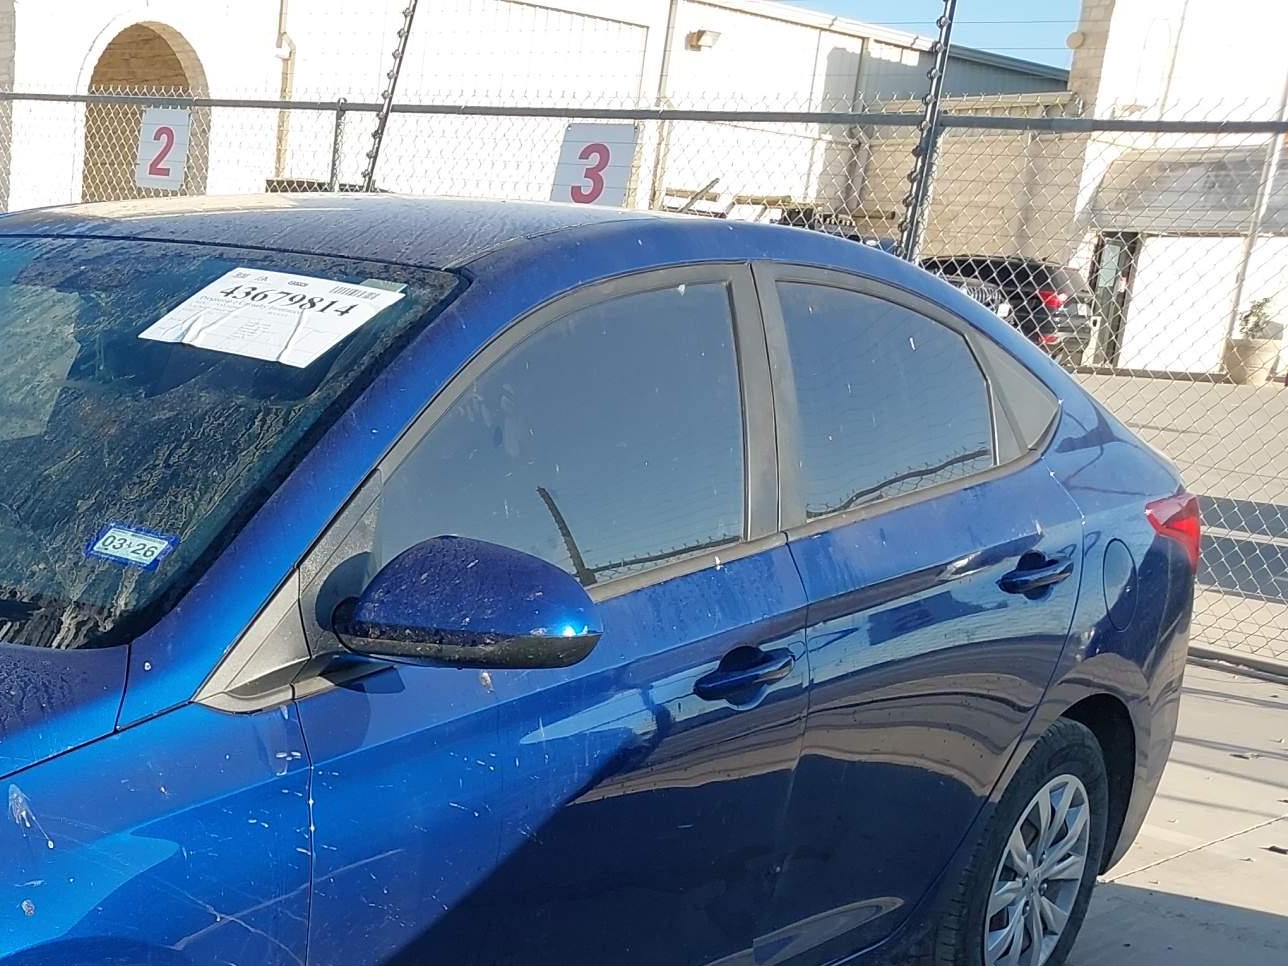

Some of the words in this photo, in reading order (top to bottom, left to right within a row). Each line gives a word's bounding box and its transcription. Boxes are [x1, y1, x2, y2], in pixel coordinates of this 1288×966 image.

[148, 126, 175, 177] 2
[570, 143, 610, 204] 3
[219, 284, 359, 318] 43679814
[101, 535, 128, 550] 03
[130, 542, 159, 558] 26
